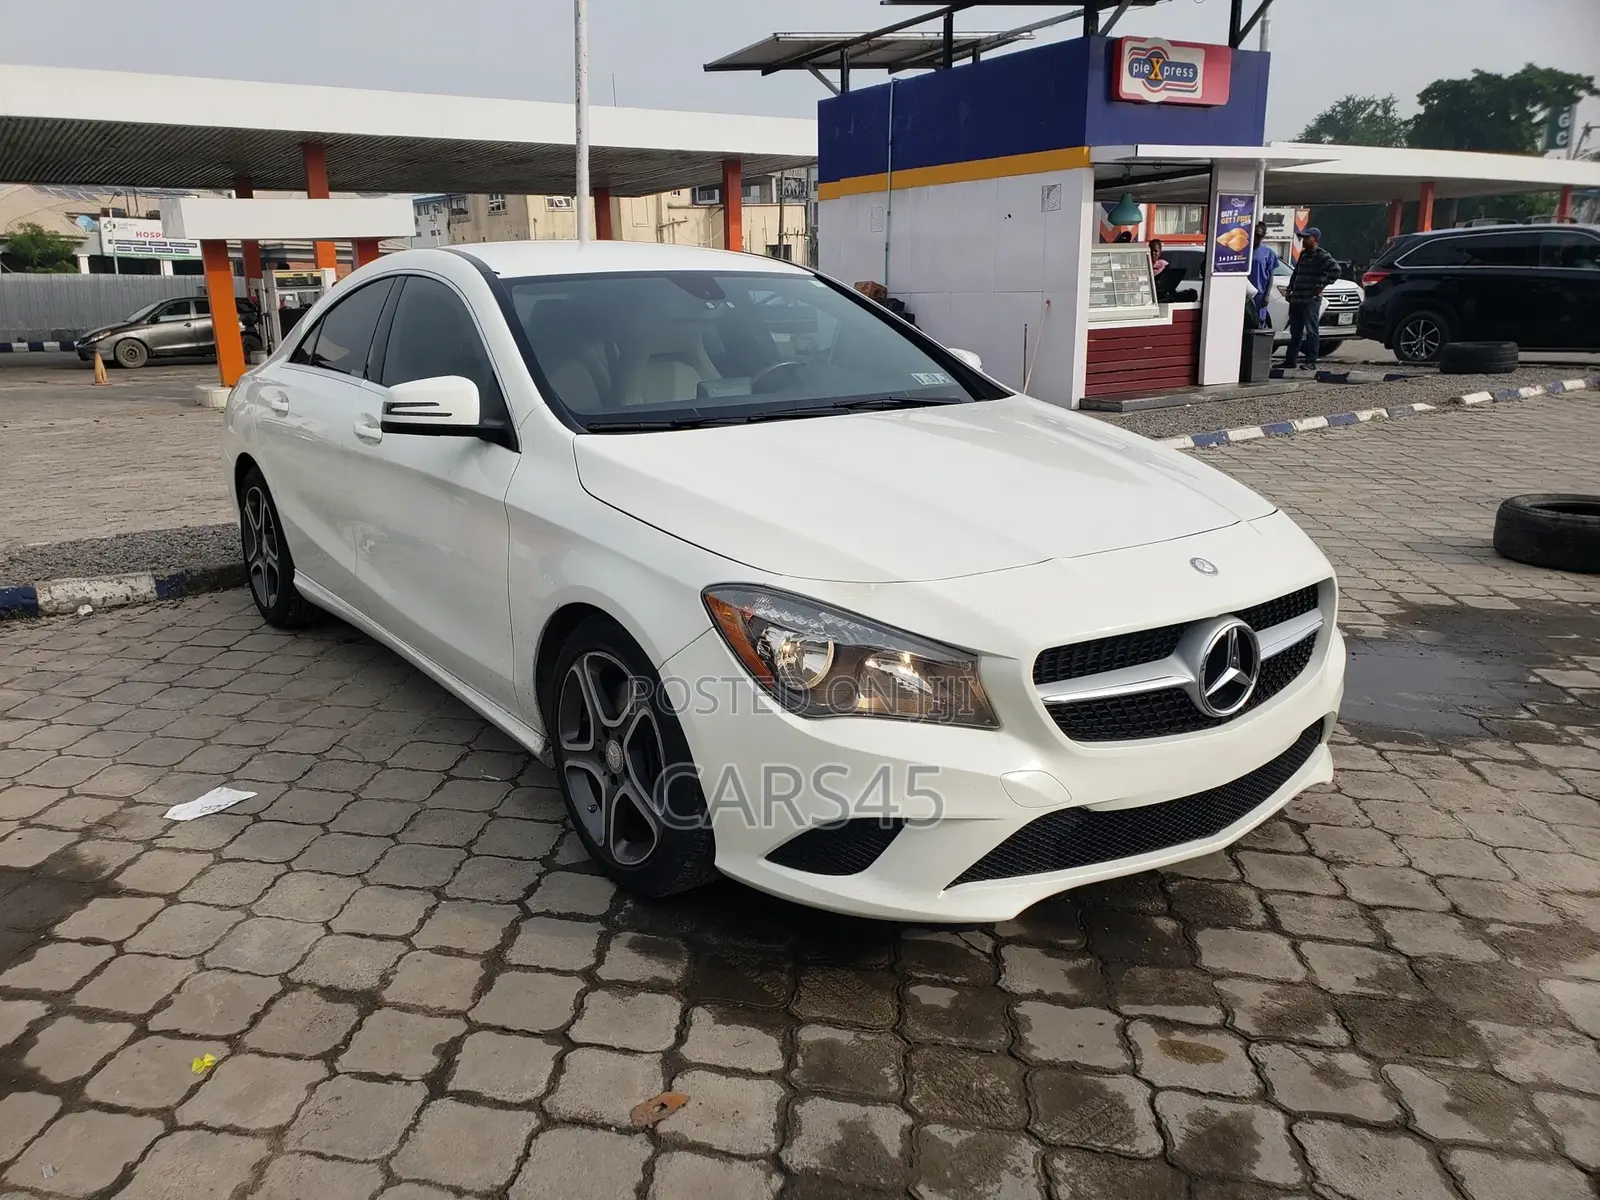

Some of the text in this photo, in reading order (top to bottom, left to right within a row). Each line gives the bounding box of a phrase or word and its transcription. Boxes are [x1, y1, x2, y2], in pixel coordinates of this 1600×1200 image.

[1132, 58, 1194, 80] pieXpress
[1221, 210, 1233, 218] BUY
[1220, 217, 1232, 225] GET
